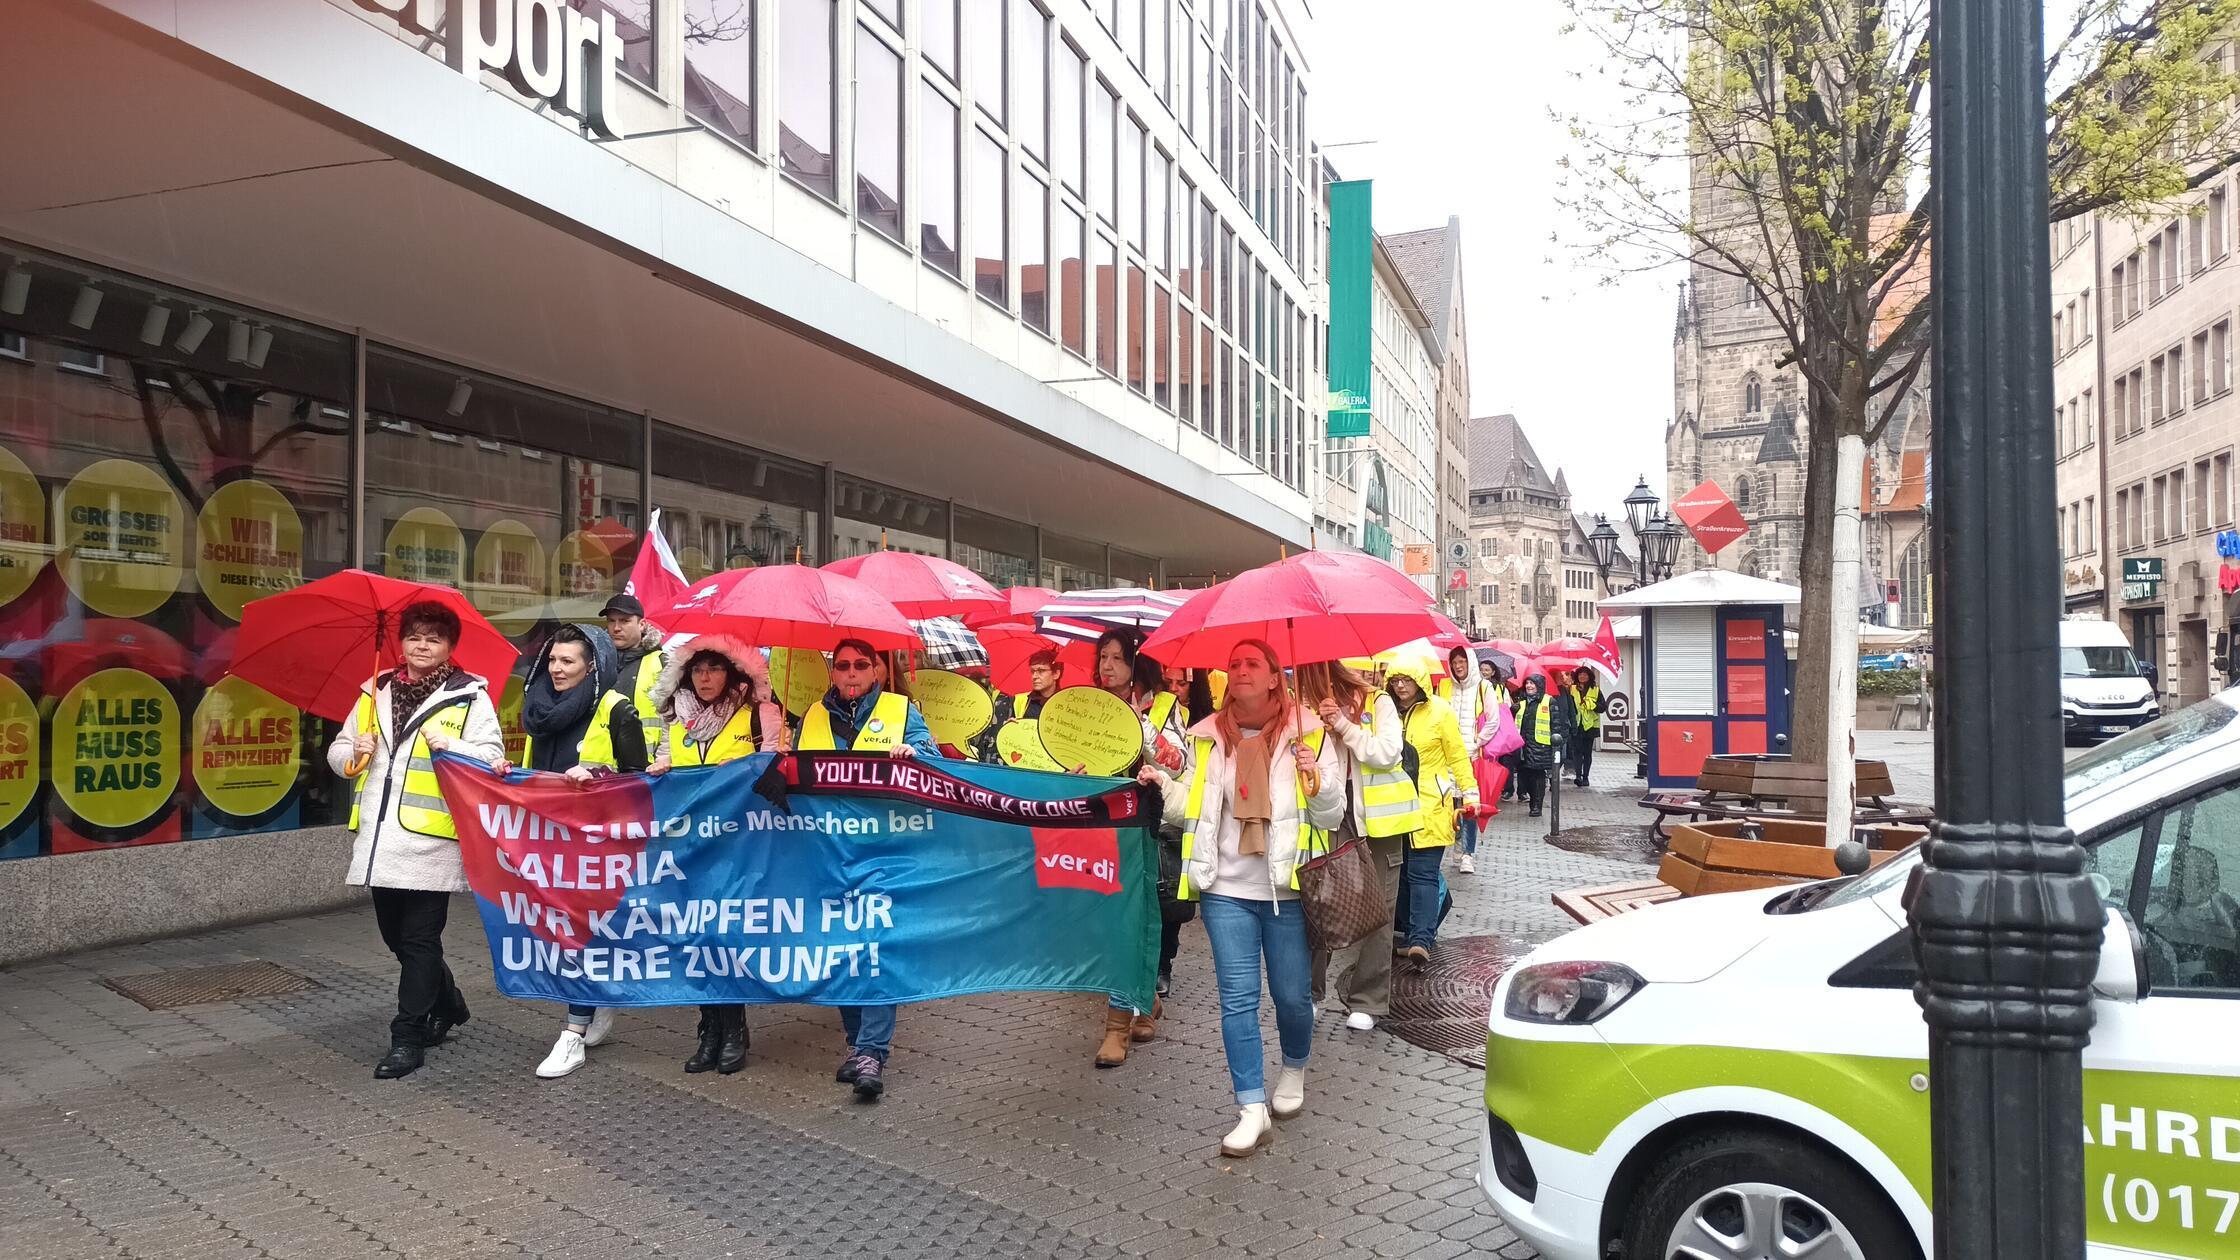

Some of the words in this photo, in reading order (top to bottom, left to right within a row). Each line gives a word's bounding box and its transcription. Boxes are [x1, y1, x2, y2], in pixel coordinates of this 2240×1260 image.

[1337, 395, 1368, 406] GALERIA
[70, 505, 170, 533] GROSSER
[231, 517, 275, 546] WIR
[1696, 525, 1745, 533] Straßenkreuzer
[202, 542, 298, 569] SCHLIESSEN
[220, 573, 248, 585] DIESE
[2120, 583, 2144, 600] MEPHISTO
[2126, 573, 2162, 581] MEPHISTO
[75, 698, 163, 727] ALLES
[75, 729, 162, 760] MUSS
[203, 717, 293, 746] ALLES
[863, 736, 892, 744] ver.di
[202, 747, 293, 769] REDUZIERT
[74, 761, 162, 794] RAUS
[814, 761, 884, 785] YOU'LL
[890, 764, 957, 800] NEVER
[960, 786, 1016, 815] WALK
[1019, 800, 1092, 817] ALONE
[698, 815, 739, 838] die
[746, 809, 880, 835] Menschen
[888, 807, 934, 833] bei
[1041, 852, 1115, 884] ver.di
[588, 897, 805, 940] KÄMPFEN
[821, 888, 894, 933] FÜR
[502, 936, 672, 982] UNSERE
[682, 941, 880, 984] ZUKUNFT!
[2083, 1103, 2240, 1163] HRD
[2103, 1172, 2240, 1234] (017
